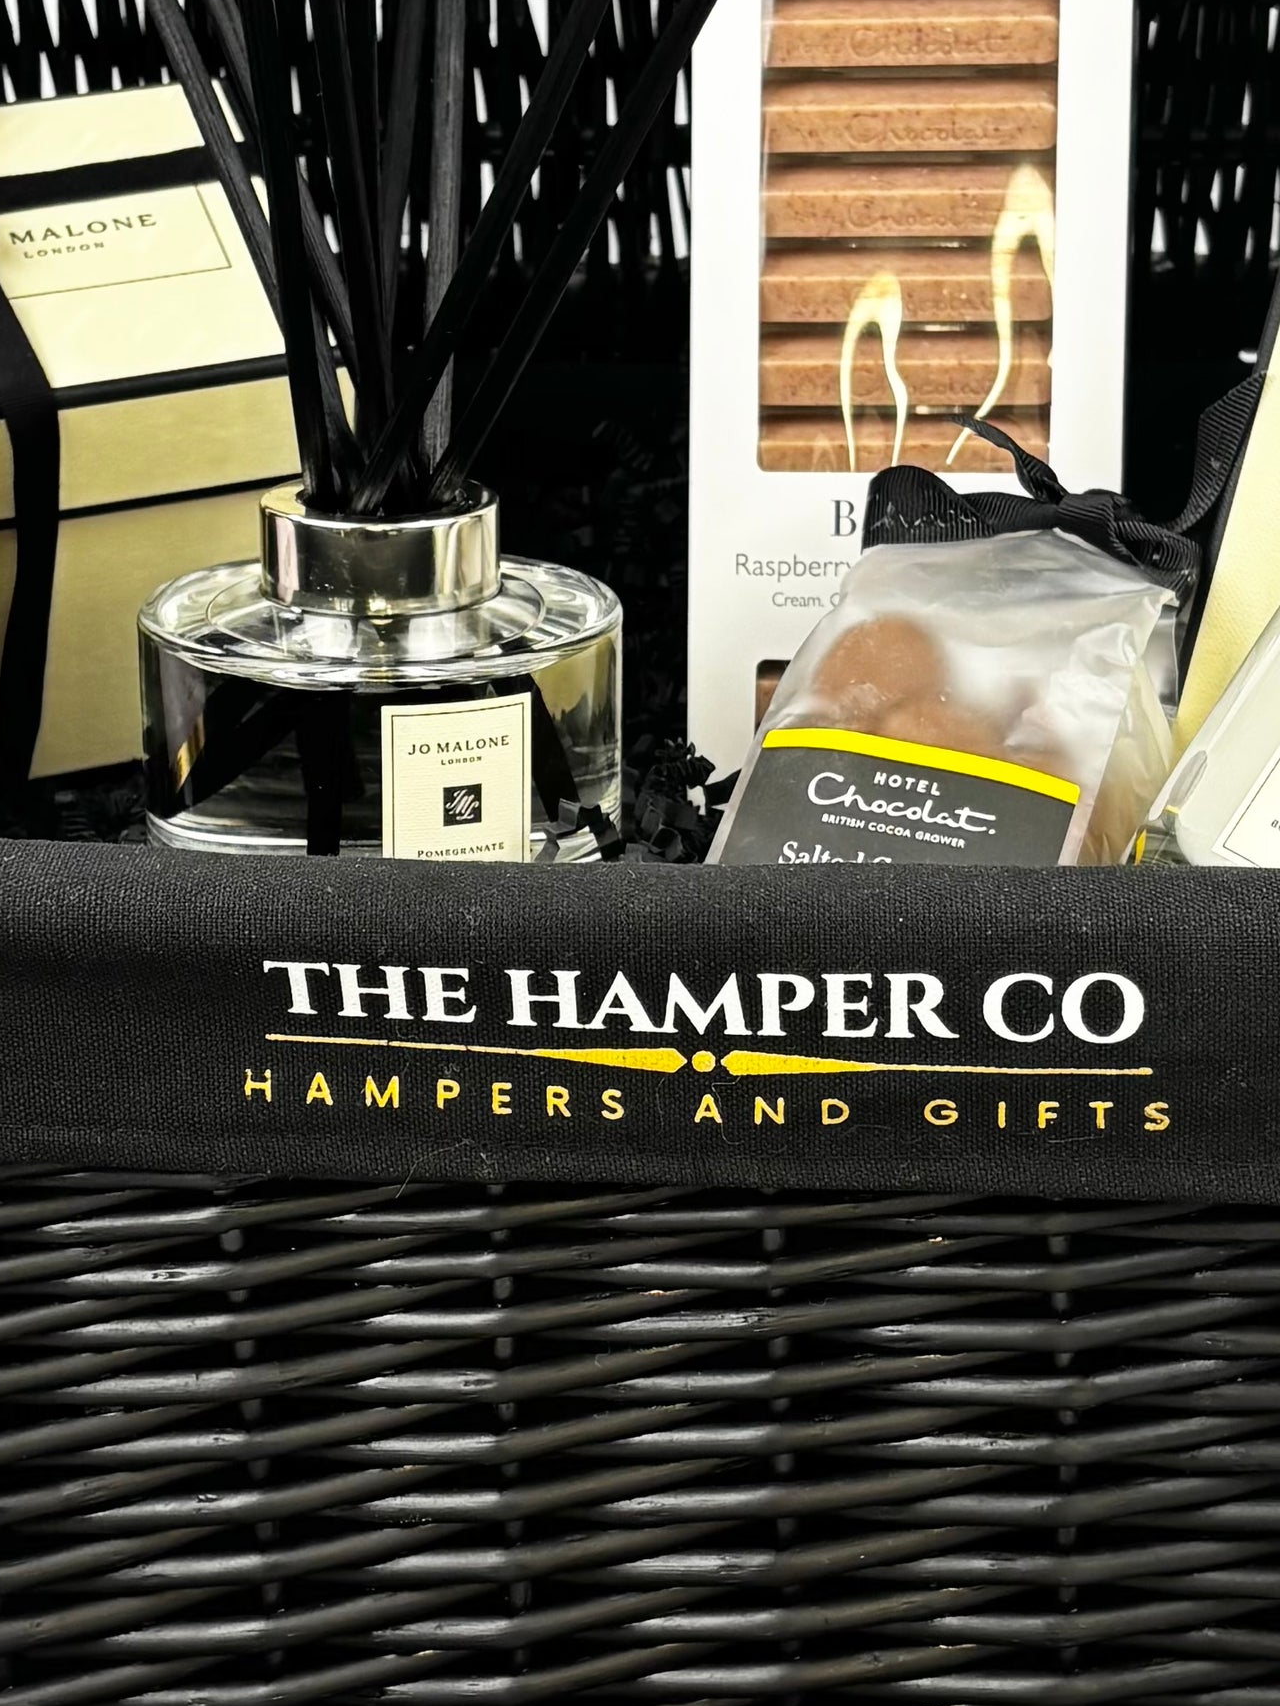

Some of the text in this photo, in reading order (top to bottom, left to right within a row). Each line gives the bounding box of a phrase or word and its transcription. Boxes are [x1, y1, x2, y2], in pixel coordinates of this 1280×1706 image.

[9, 214, 157, 245] MALONE
[24, 242, 105, 259] LONDON
[408, 735, 510, 755] JO MALONE
[441, 756, 482, 765] LONDON
[873, 771, 941, 797] HOTEL
[821, 813, 966, 849] BRITISH COCOA GROWER
[417, 842, 505, 858] POMEGRANATE
[263, 960, 1147, 1044] THE HAMPER CO
[244, 1067, 1172, 1132] HAMPERS AND GIFTS
